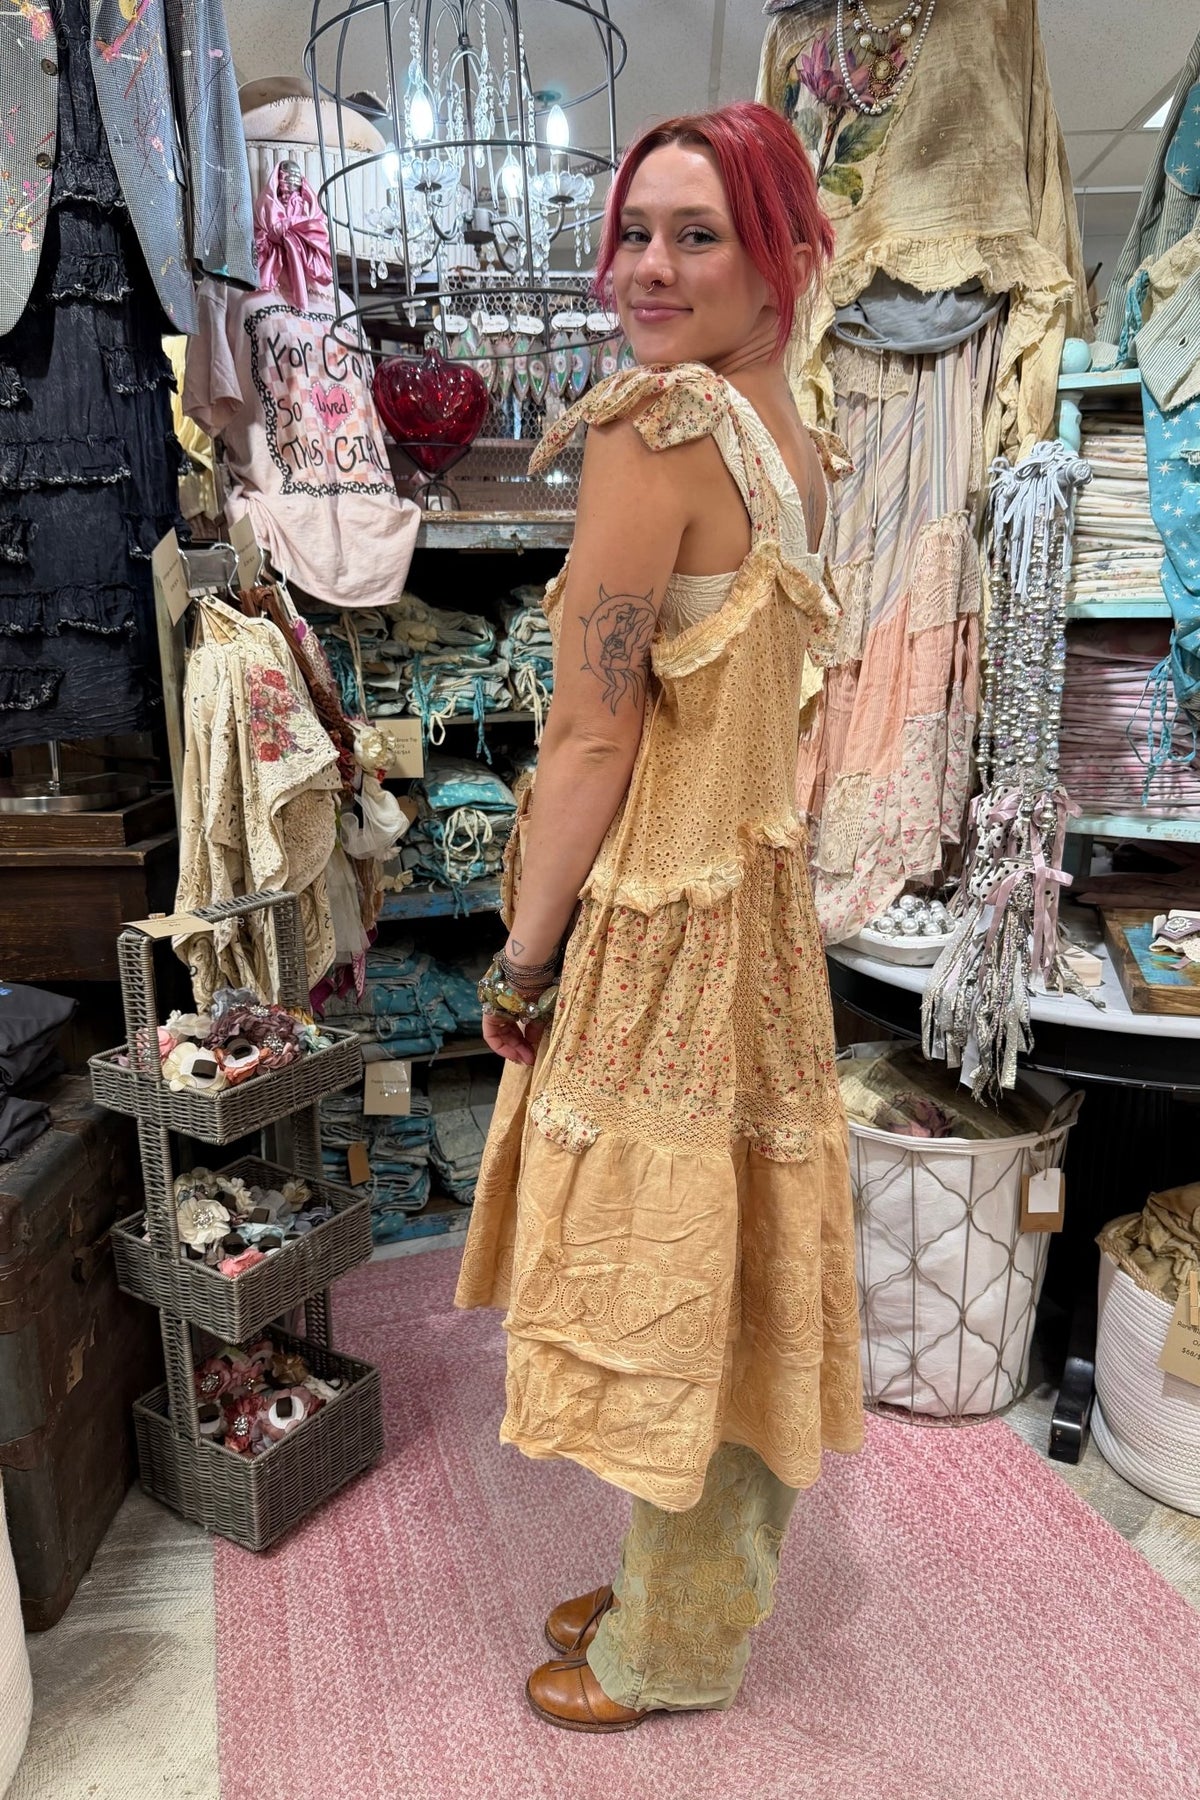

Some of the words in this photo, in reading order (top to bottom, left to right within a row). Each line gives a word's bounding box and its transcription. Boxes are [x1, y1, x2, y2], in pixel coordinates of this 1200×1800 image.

[266, 332, 313, 383] For
[322, 333, 370, 387] Go
[276, 397, 303, 429] So
[315, 393, 349, 417] loved
[281, 435, 324, 470] This
